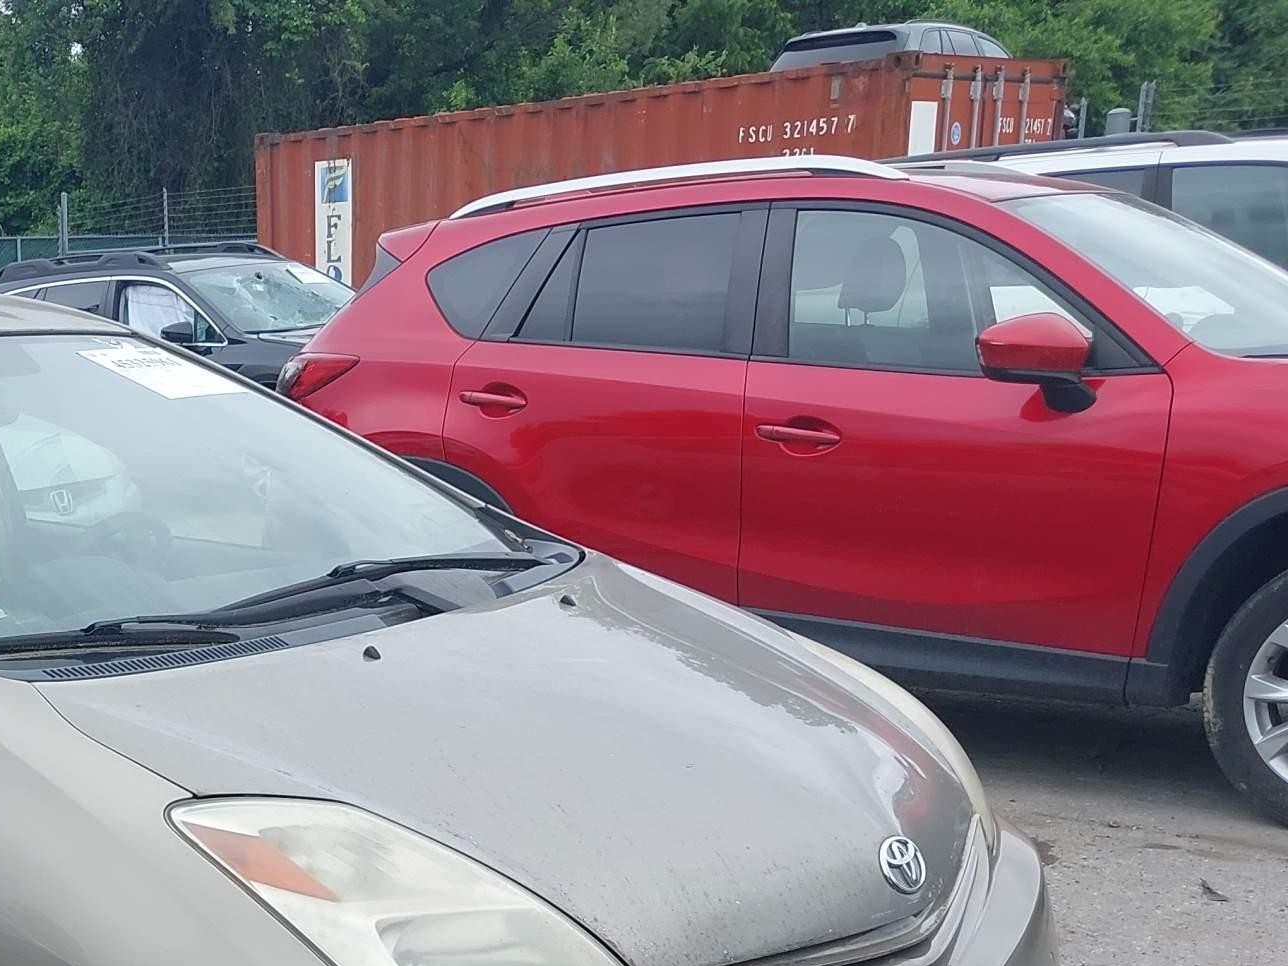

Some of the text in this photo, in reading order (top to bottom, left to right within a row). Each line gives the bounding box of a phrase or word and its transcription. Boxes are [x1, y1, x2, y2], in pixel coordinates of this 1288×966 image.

[738, 114, 857, 143] FSCU 321457 7
